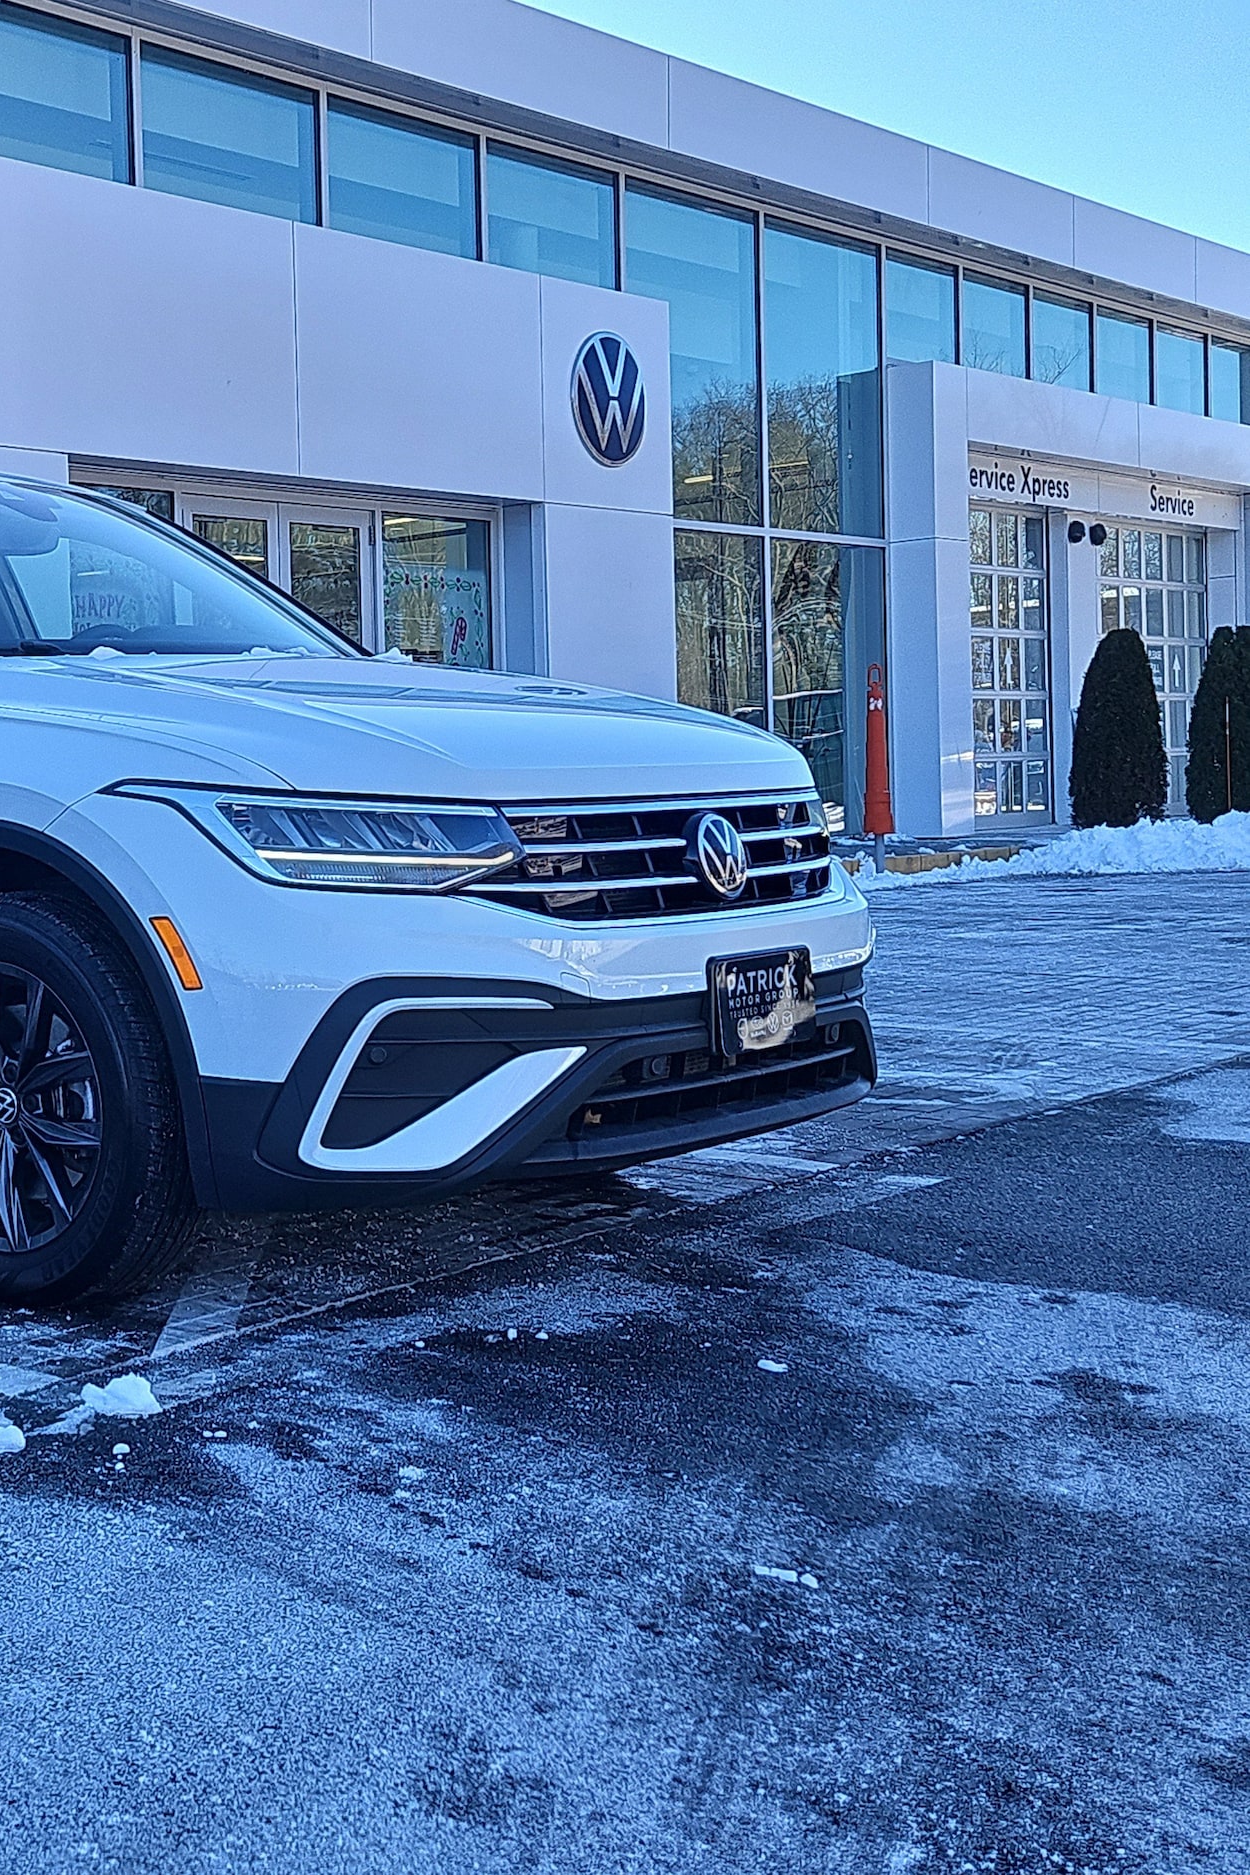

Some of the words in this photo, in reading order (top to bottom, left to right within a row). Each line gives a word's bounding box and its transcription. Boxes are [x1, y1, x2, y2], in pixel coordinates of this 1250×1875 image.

[969, 462, 1016, 492] ervice
[1020, 465, 1070, 502] Xpress
[1149, 484, 1195, 516] Service
[74, 592, 125, 618] HAPPY
[726, 964, 798, 997] PATRICK
[729, 993, 760, 1010] MOTOR
[765, 987, 799, 1002] GROUP
[730, 1007, 759, 1019] TRUSTED
